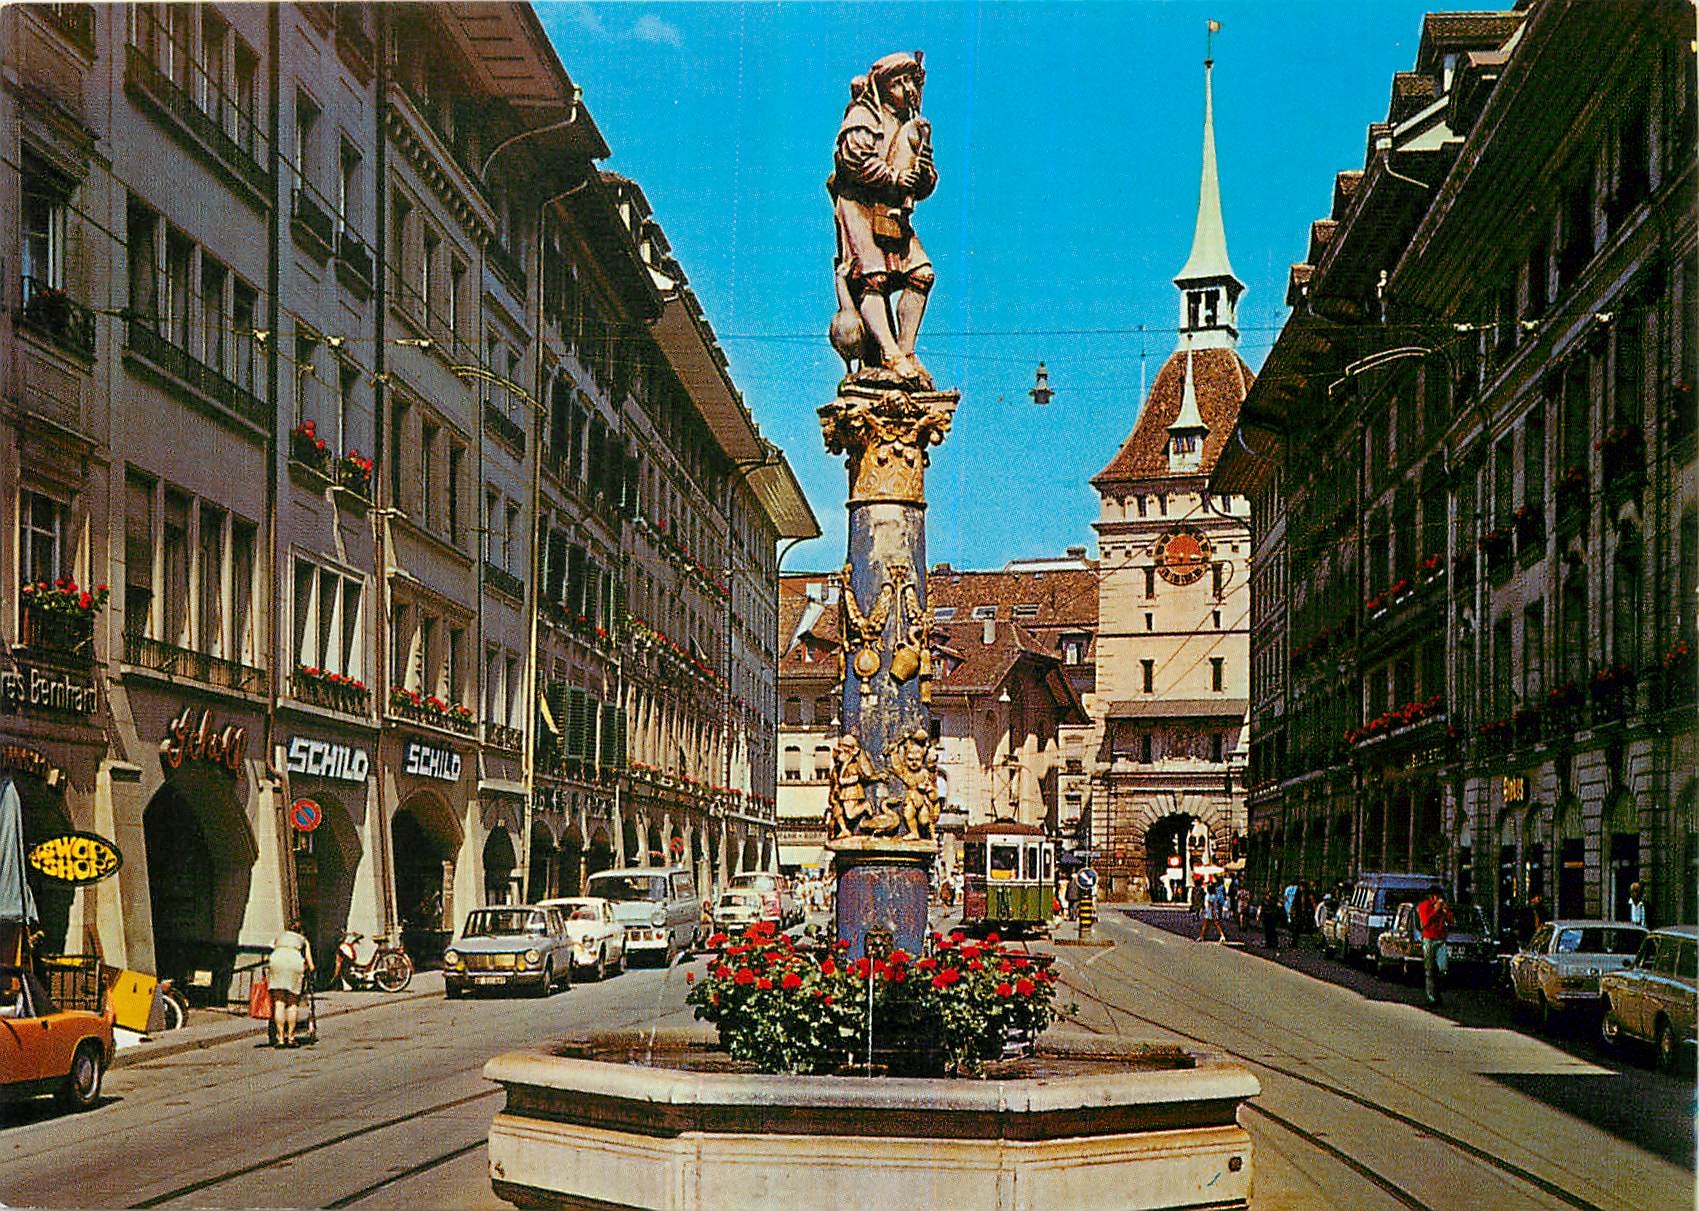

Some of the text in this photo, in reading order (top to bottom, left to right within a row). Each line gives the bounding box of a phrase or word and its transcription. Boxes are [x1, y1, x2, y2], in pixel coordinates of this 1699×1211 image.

[31, 667, 98, 715] Bernhard
[287, 736, 369, 782] SCHILD
[406, 743, 461, 781] SCHILD
[42, 858, 107, 881] SHOP
